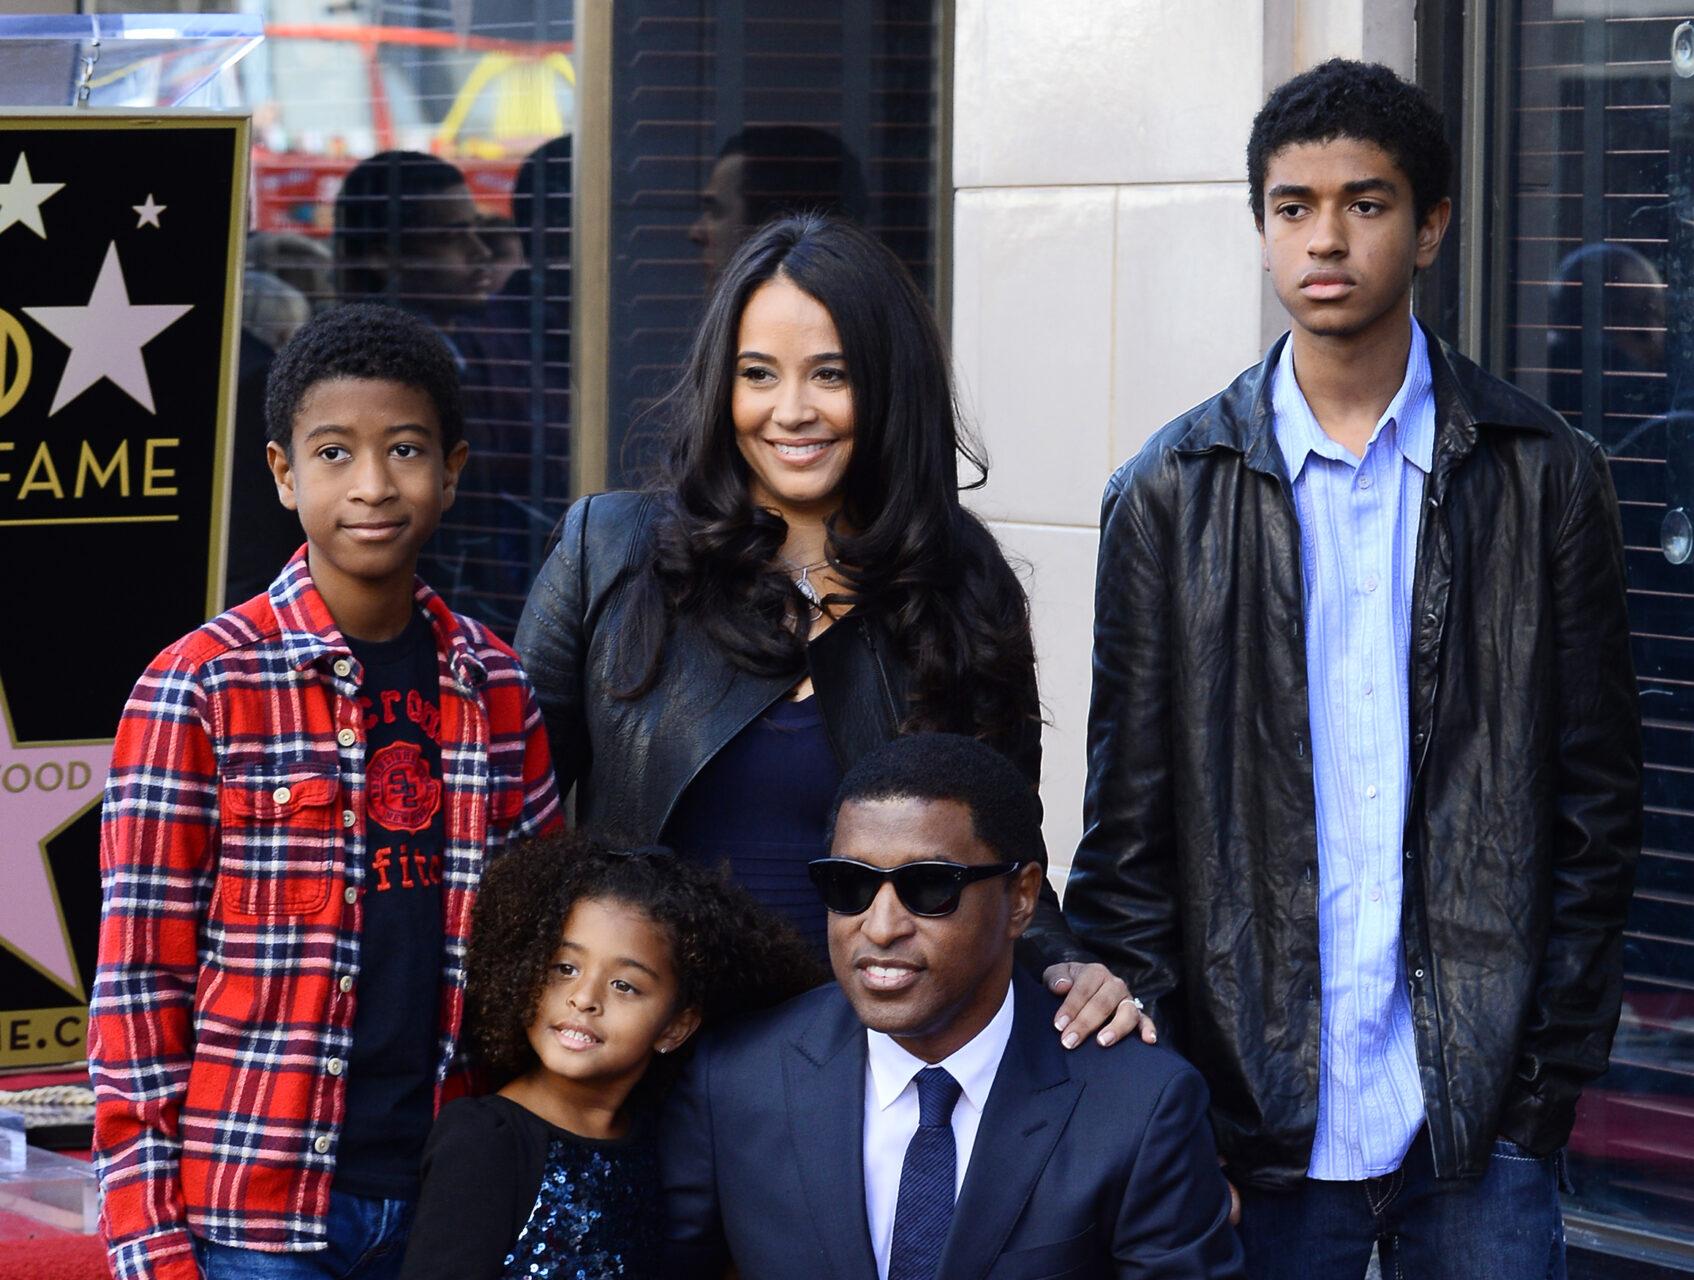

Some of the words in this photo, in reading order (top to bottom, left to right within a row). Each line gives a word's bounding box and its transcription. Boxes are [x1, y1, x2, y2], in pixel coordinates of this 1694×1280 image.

[0, 438, 180, 500] AME
[0, 761, 92, 793] OOD
[0, 1015, 82, 1051] E.C
